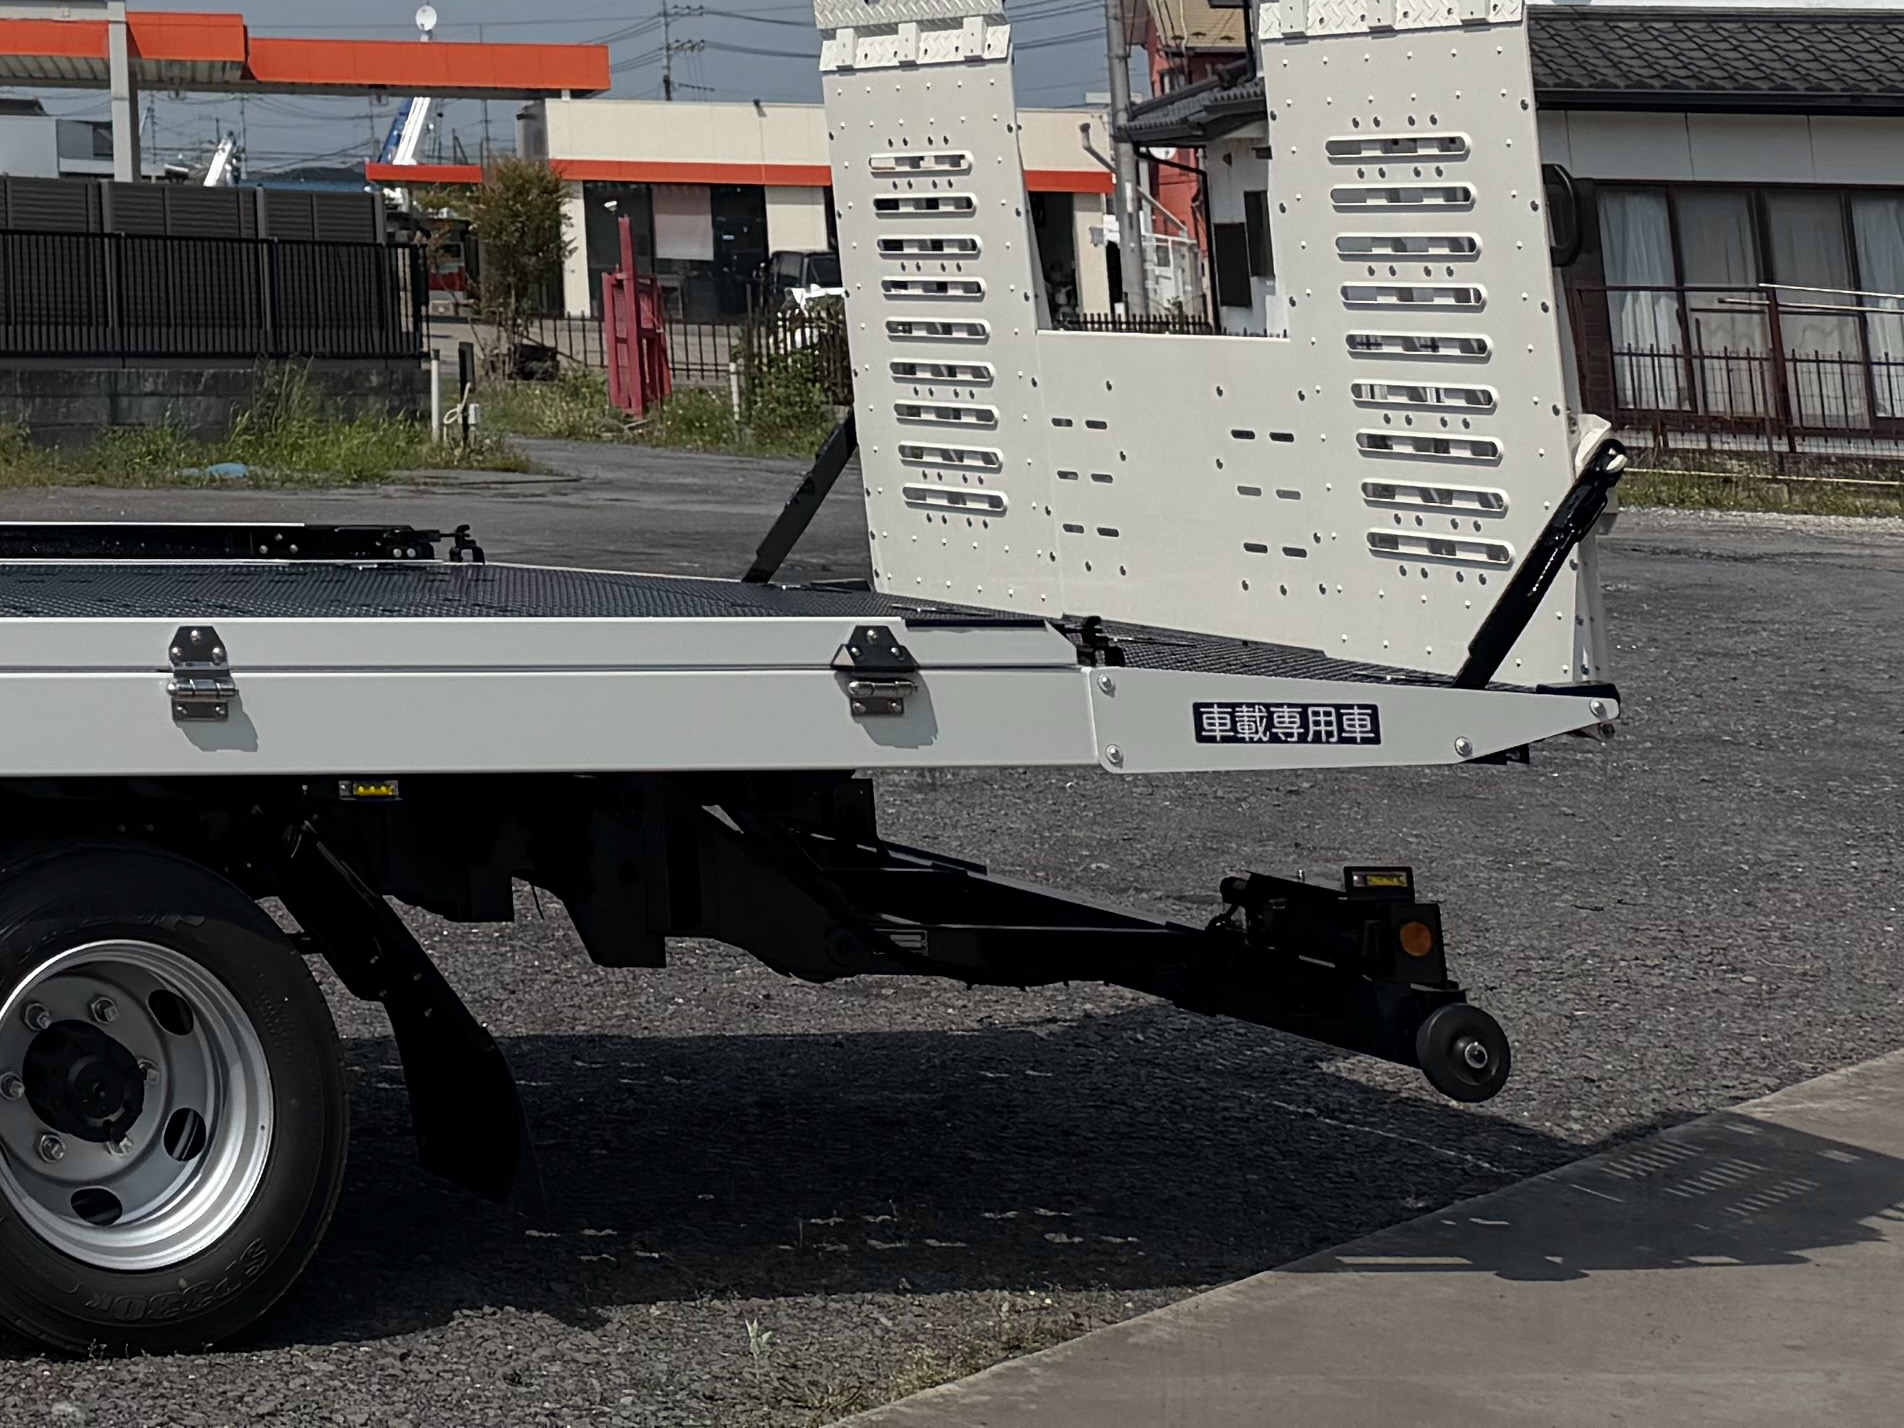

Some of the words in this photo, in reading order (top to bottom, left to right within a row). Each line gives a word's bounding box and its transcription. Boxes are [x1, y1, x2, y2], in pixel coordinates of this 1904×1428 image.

[1199, 703, 1376, 744] 車載専用車
